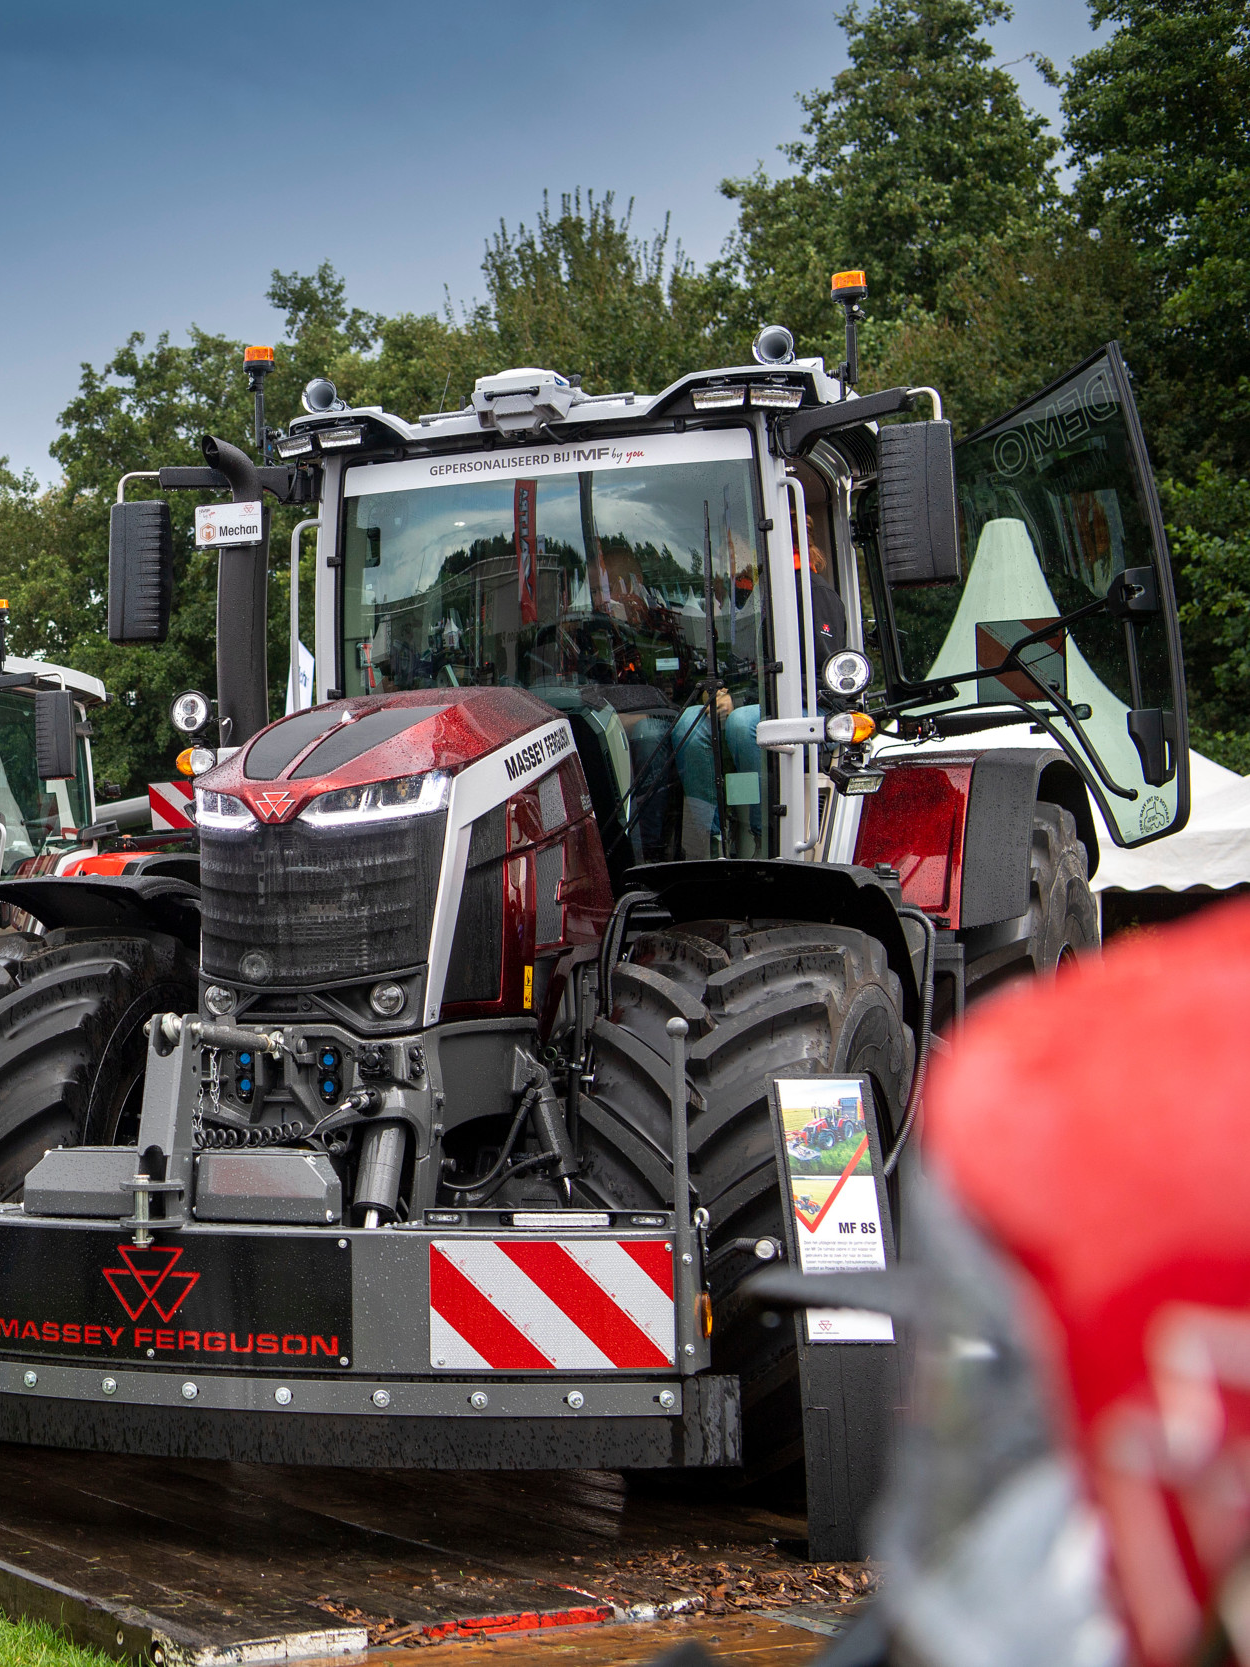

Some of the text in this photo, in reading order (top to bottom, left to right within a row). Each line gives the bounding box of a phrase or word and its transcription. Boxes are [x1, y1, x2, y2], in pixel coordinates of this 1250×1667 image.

[430, 454, 550, 476] GEPERSONALISEERD
[553, 452, 570, 463] BIJ
[611, 448, 623, 464] by
[626, 450, 645, 463] you
[219, 524, 258, 537] Mechan
[503, 739, 546, 781] MASSEY
[838, 1222, 877, 1234] MF 8S
[134, 1327, 339, 1357] FERGUSON
